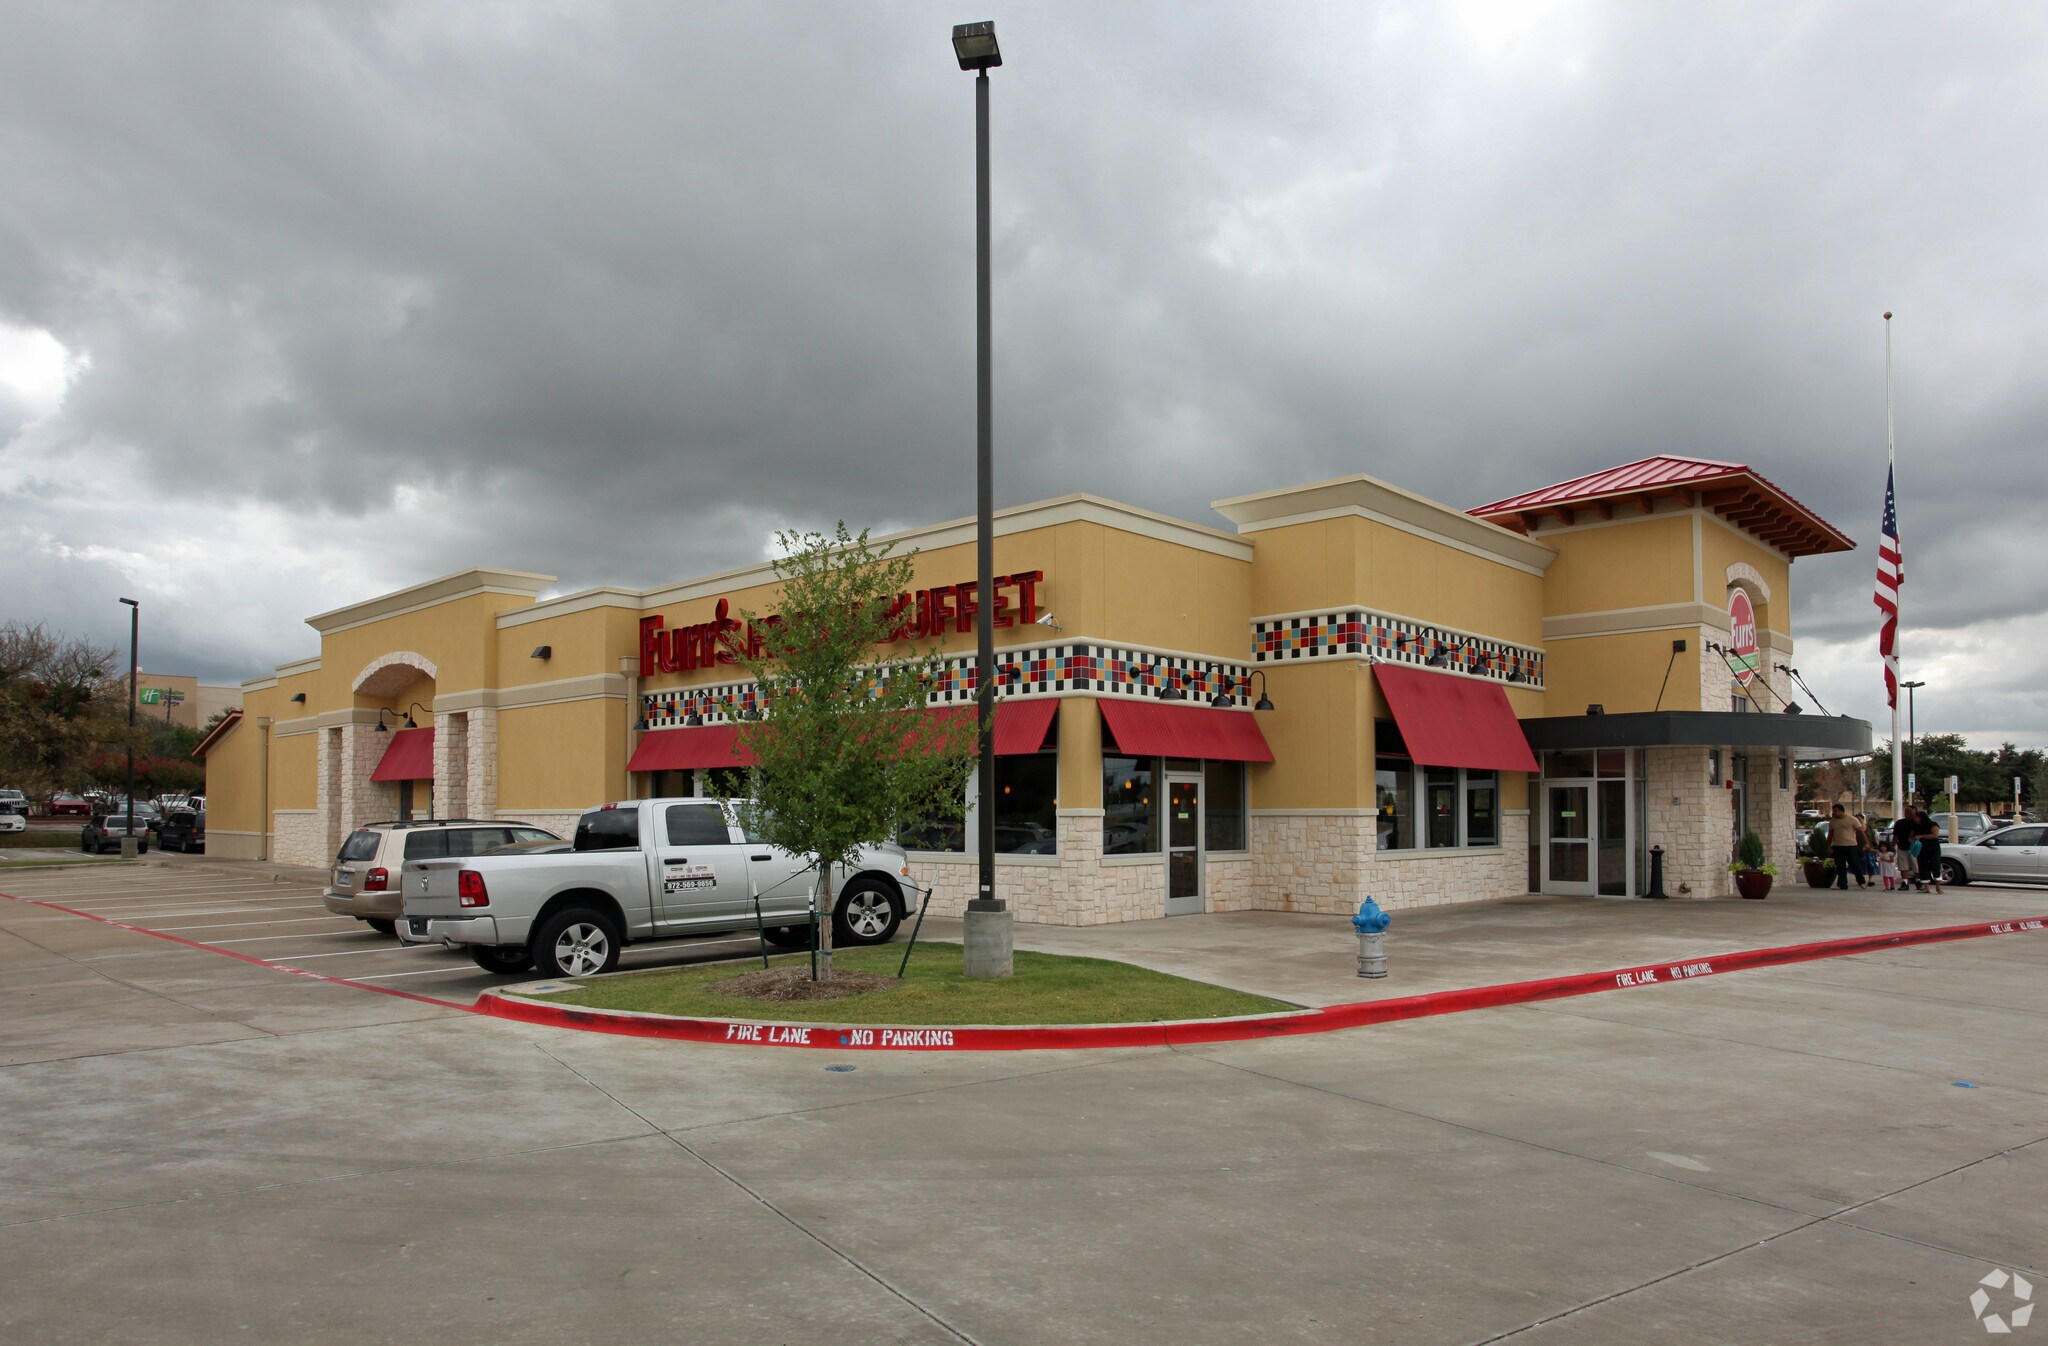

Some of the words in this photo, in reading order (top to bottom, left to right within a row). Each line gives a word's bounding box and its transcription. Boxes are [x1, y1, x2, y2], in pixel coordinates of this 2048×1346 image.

[640, 598, 744, 677] Furr's
[1730, 613, 1754, 650] Furr's
[1616, 973, 1636, 987] FIRE
[1635, 970, 1658, 984] LANE
[1670, 966, 1683, 979] NO
[1682, 962, 1713, 978] PARKING
[726, 1024, 764, 1041] FIRE
[768, 1026, 812, 1045] LANE
[850, 1029, 874, 1045] NO
[881, 1029, 954, 1047] PARKING
